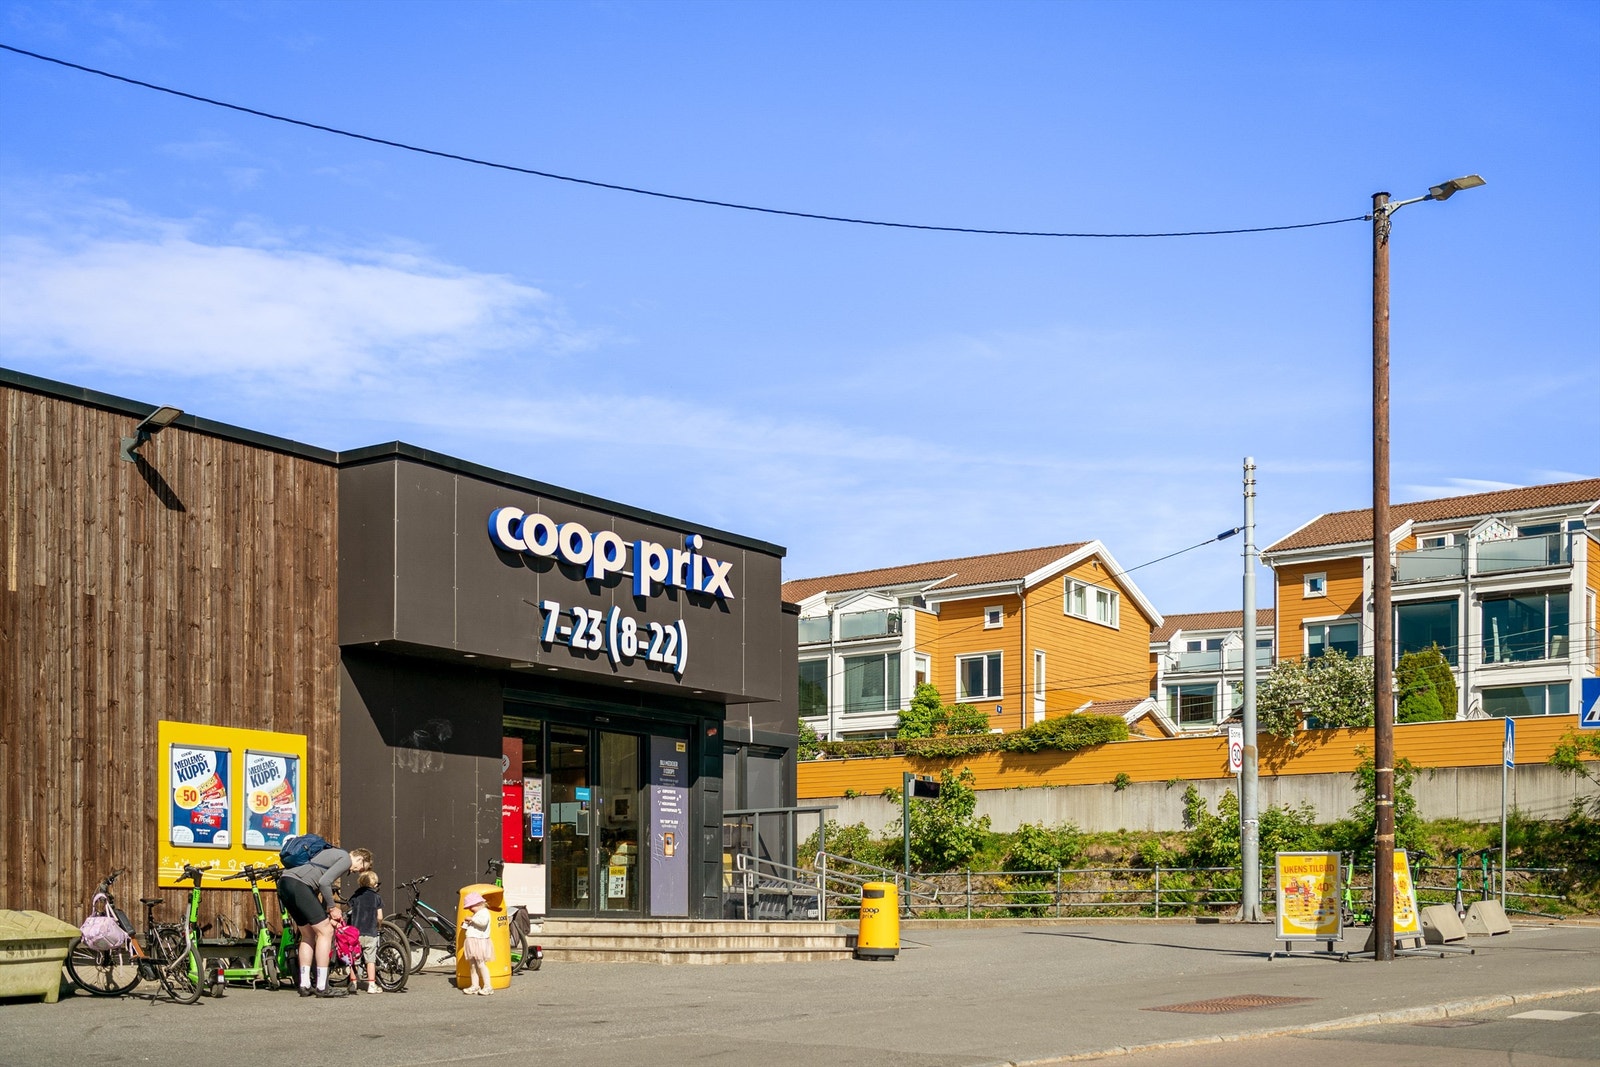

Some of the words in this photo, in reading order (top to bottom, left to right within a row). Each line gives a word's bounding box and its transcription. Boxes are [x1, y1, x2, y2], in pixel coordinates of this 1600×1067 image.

[489, 506, 627, 580] coop
[634, 534, 735, 599] prix
[540, 600, 602, 651] 7-23
[606, 605, 688, 675] (8-22)
[1230, 729, 1241, 738] Sone
[174, 753, 205, 770] MEDLEMS-
[1233, 749, 1241, 761] 30
[177, 760, 210, 783] KUPP!
[248, 760, 276, 775] MEDLEMS-
[250, 766, 281, 788] KUPP!
[183, 789, 197, 802] 50
[255, 795, 269, 806] 50
[1283, 865, 1308, 874] UKENS
[1309, 863, 1335, 873] TILBUD
[6, 943, 47, 959] SAND
